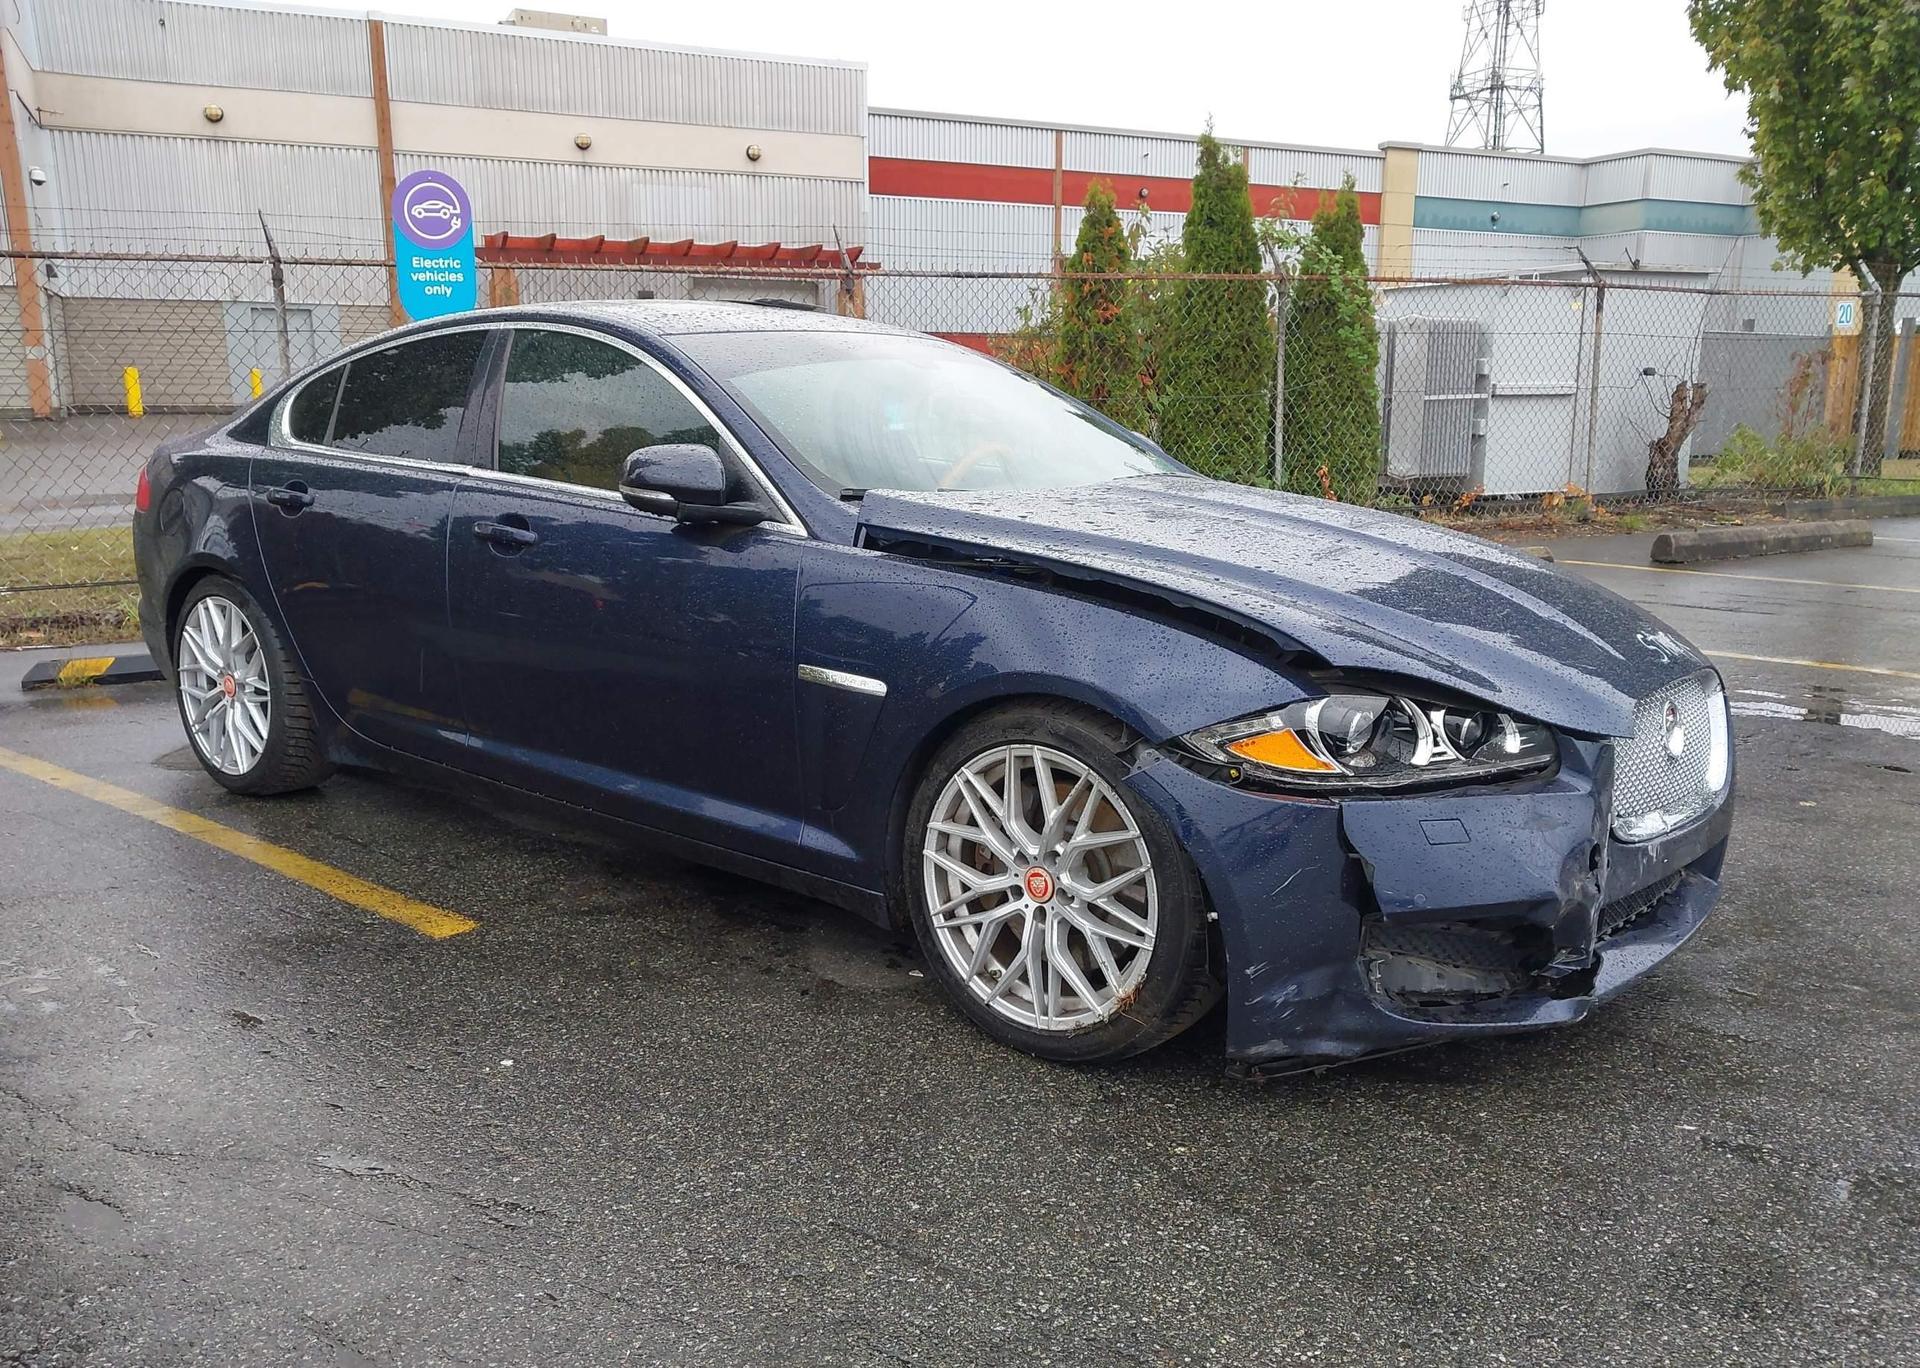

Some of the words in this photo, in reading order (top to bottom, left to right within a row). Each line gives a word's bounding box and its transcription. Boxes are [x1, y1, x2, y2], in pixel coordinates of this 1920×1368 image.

[412, 256, 461, 268] Electric
[411, 270, 464, 282] vehicles
[424, 284, 453, 298] only
[1838, 303, 1852, 324] 20
